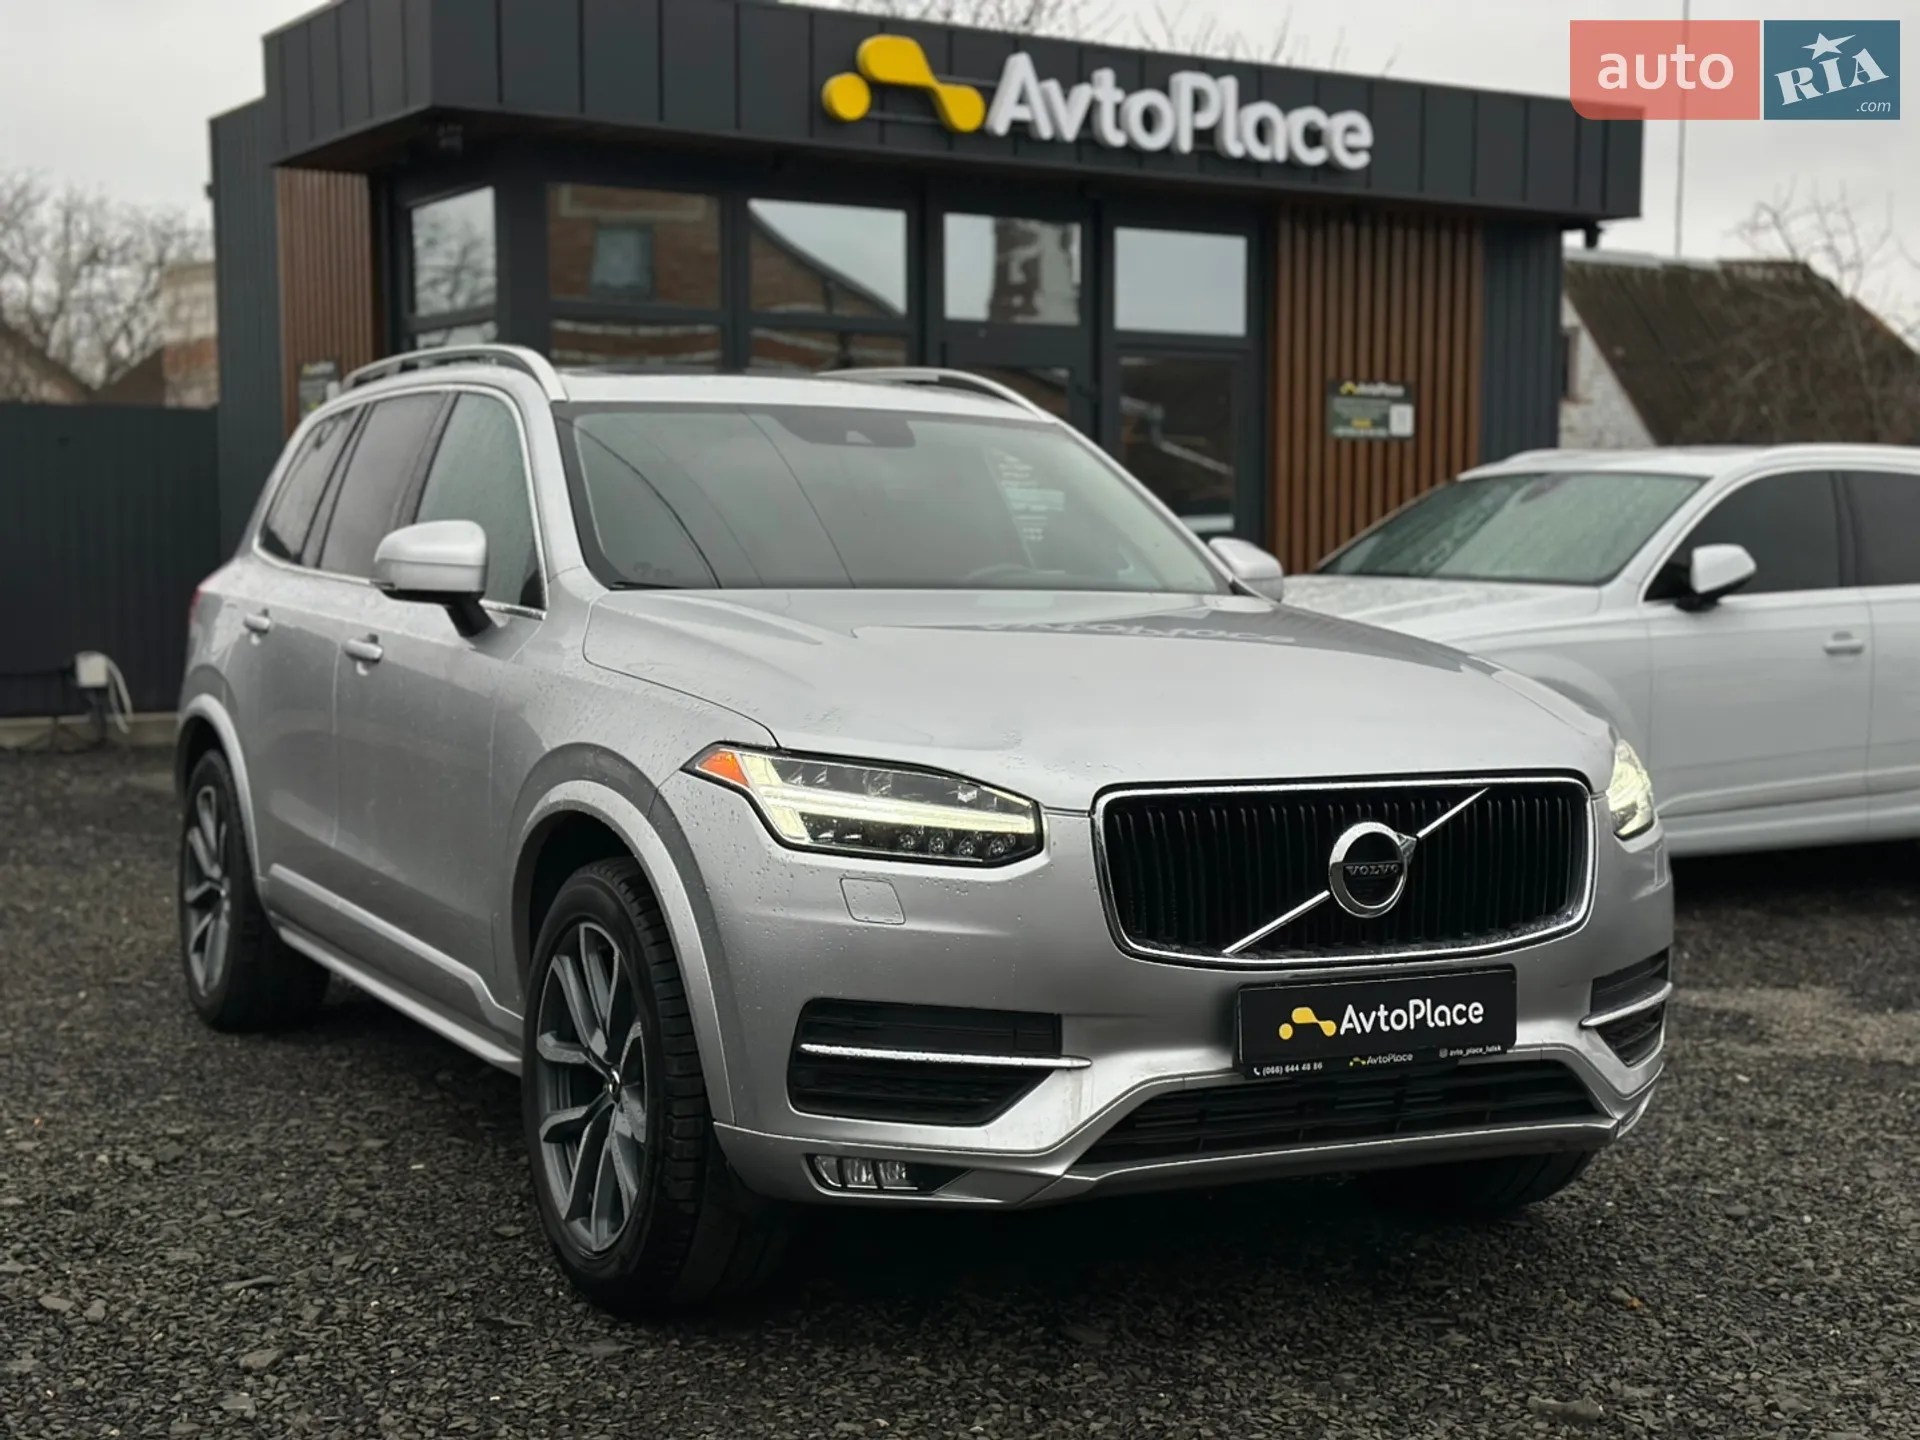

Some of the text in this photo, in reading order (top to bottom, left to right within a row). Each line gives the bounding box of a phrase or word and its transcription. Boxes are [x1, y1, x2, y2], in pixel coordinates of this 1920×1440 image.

[984, 51, 1373, 170] AvtoPlace
[1345, 863, 1400, 876] VOLVO
[1340, 998, 1484, 1036] AvtoPlace
[1366, 1053, 1414, 1065] AvtoPlace
